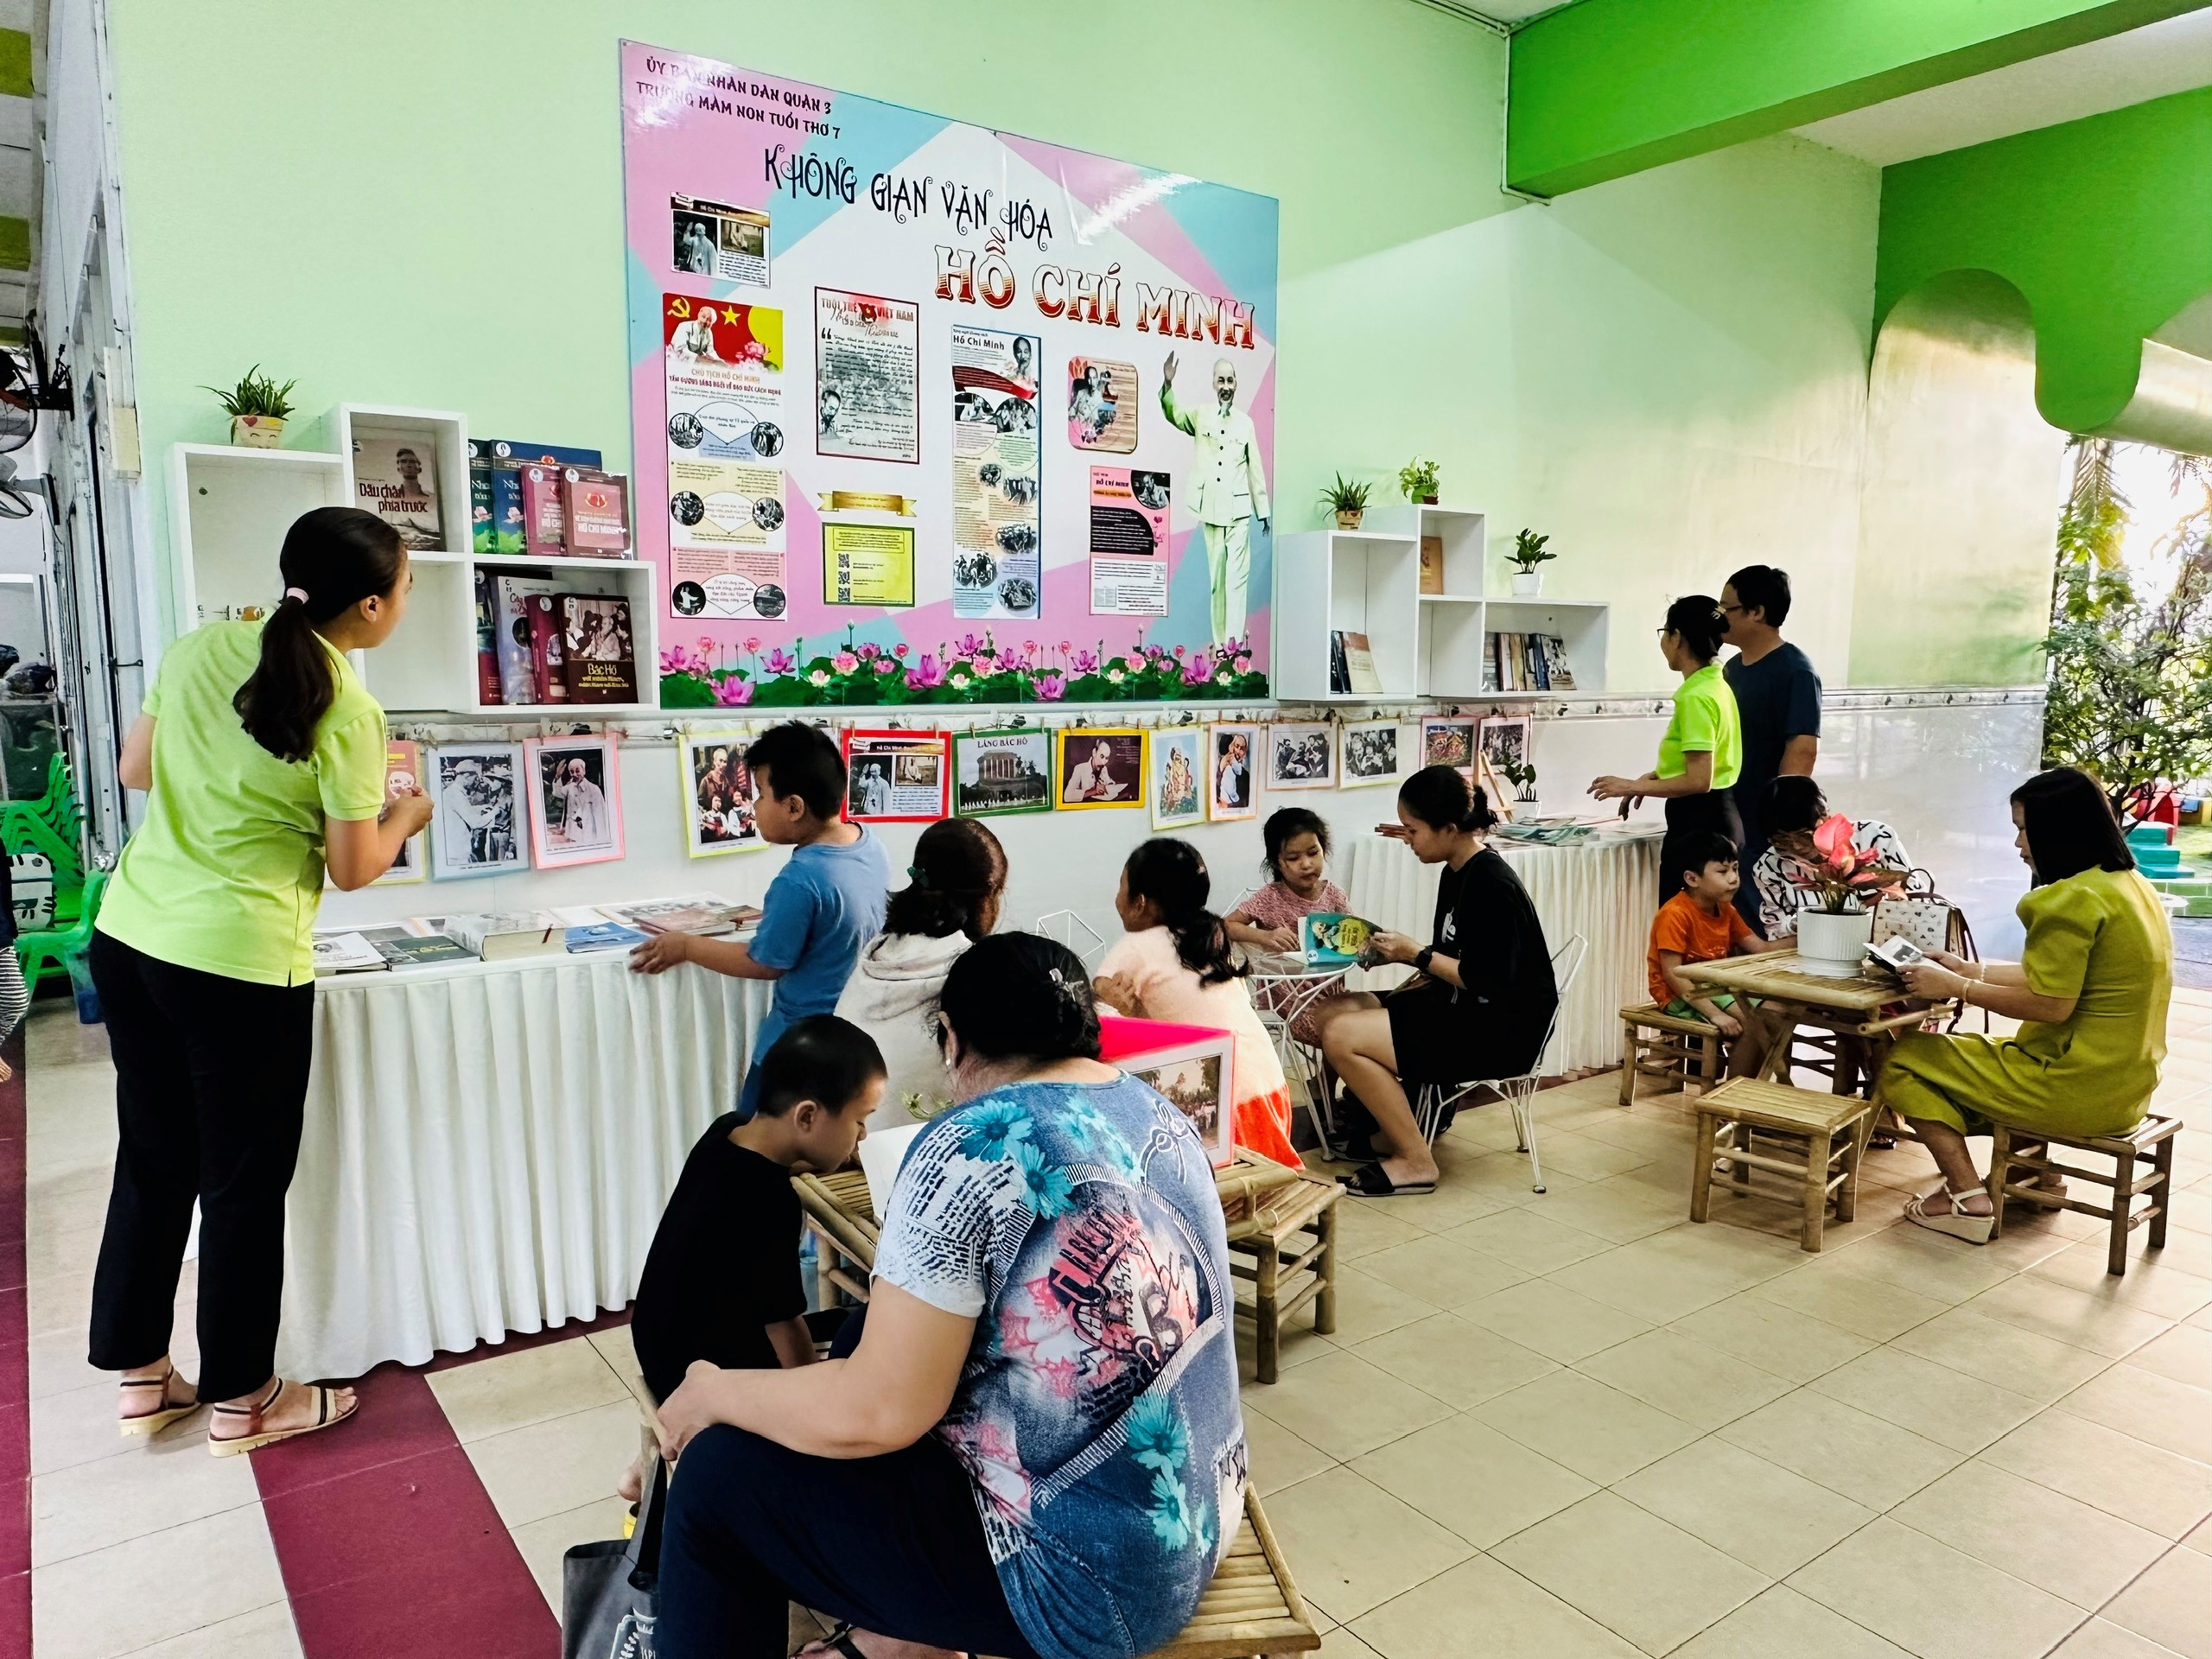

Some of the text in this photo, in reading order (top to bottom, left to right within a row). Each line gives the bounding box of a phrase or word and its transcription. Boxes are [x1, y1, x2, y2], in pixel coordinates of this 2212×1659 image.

[736, 105, 765, 122] NON
[802, 119, 830, 137] THƠ
[832, 126, 841, 140] 7
[823, 101, 831, 114] 3
[765, 143, 1053, 251] KHÔNG GIAN VĂN HÓA
[934, 226, 1255, 350] HỒ CHÍ MINH
[983, 340, 1005, 350] Minh
